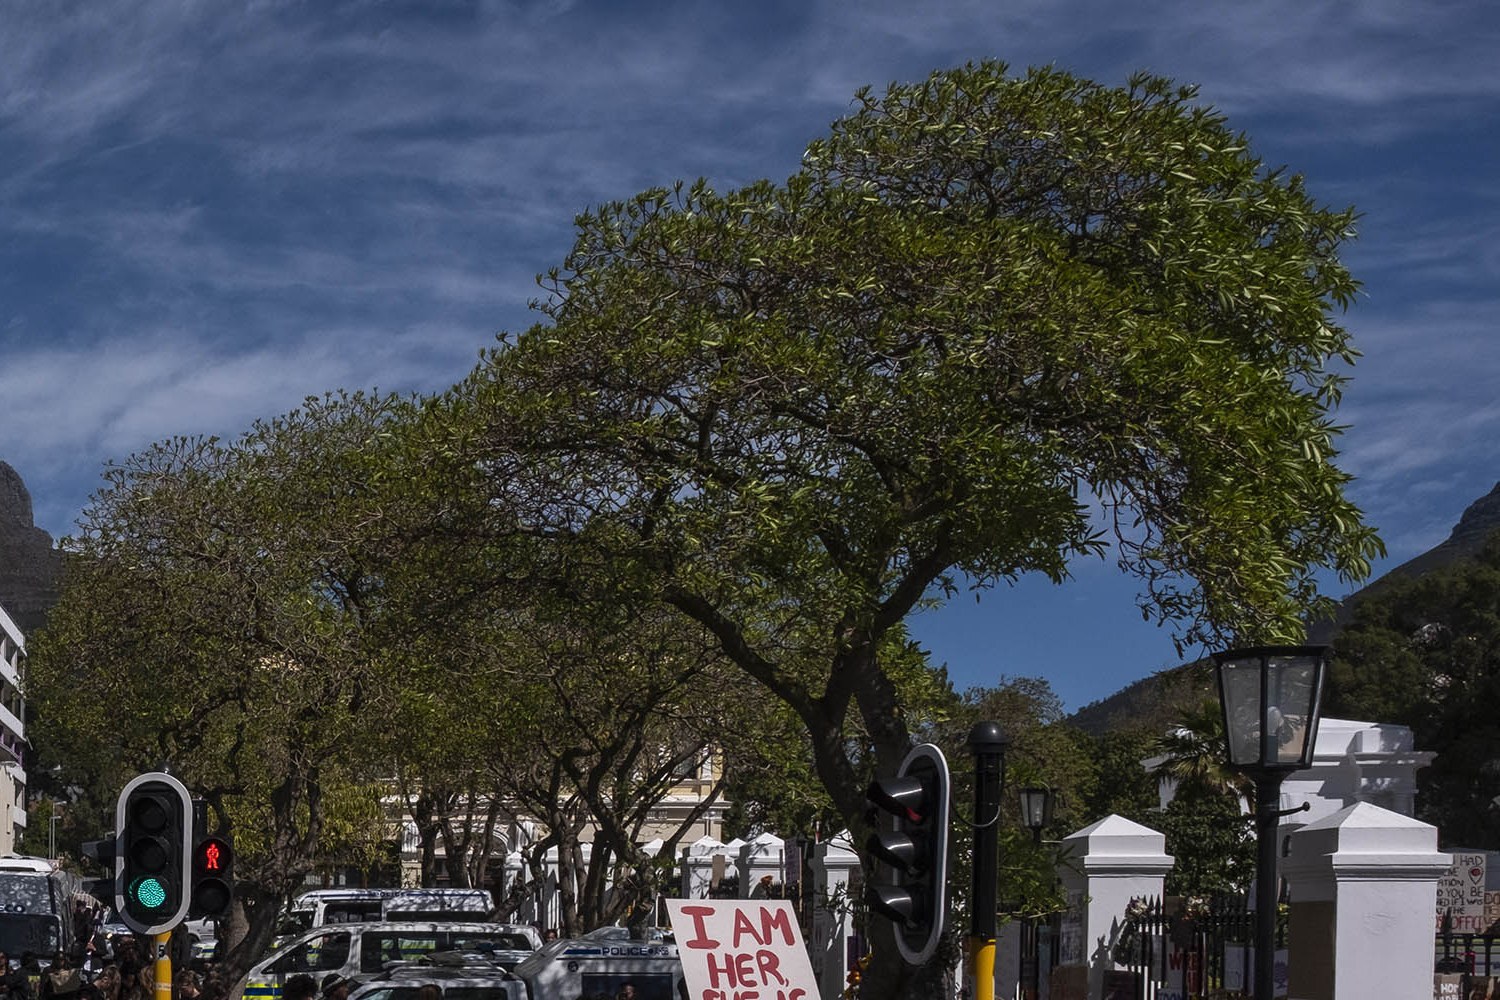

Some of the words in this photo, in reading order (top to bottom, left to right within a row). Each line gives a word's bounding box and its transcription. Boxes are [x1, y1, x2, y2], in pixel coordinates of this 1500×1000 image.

[1460, 855, 1483, 866] HAD
[1437, 879, 1464, 887] ATION
[680, 906, 721, 949] I
[733, 906, 795, 949] AM
[602, 946, 648, 956] POLICE
[707, 949, 789, 989] HER,
